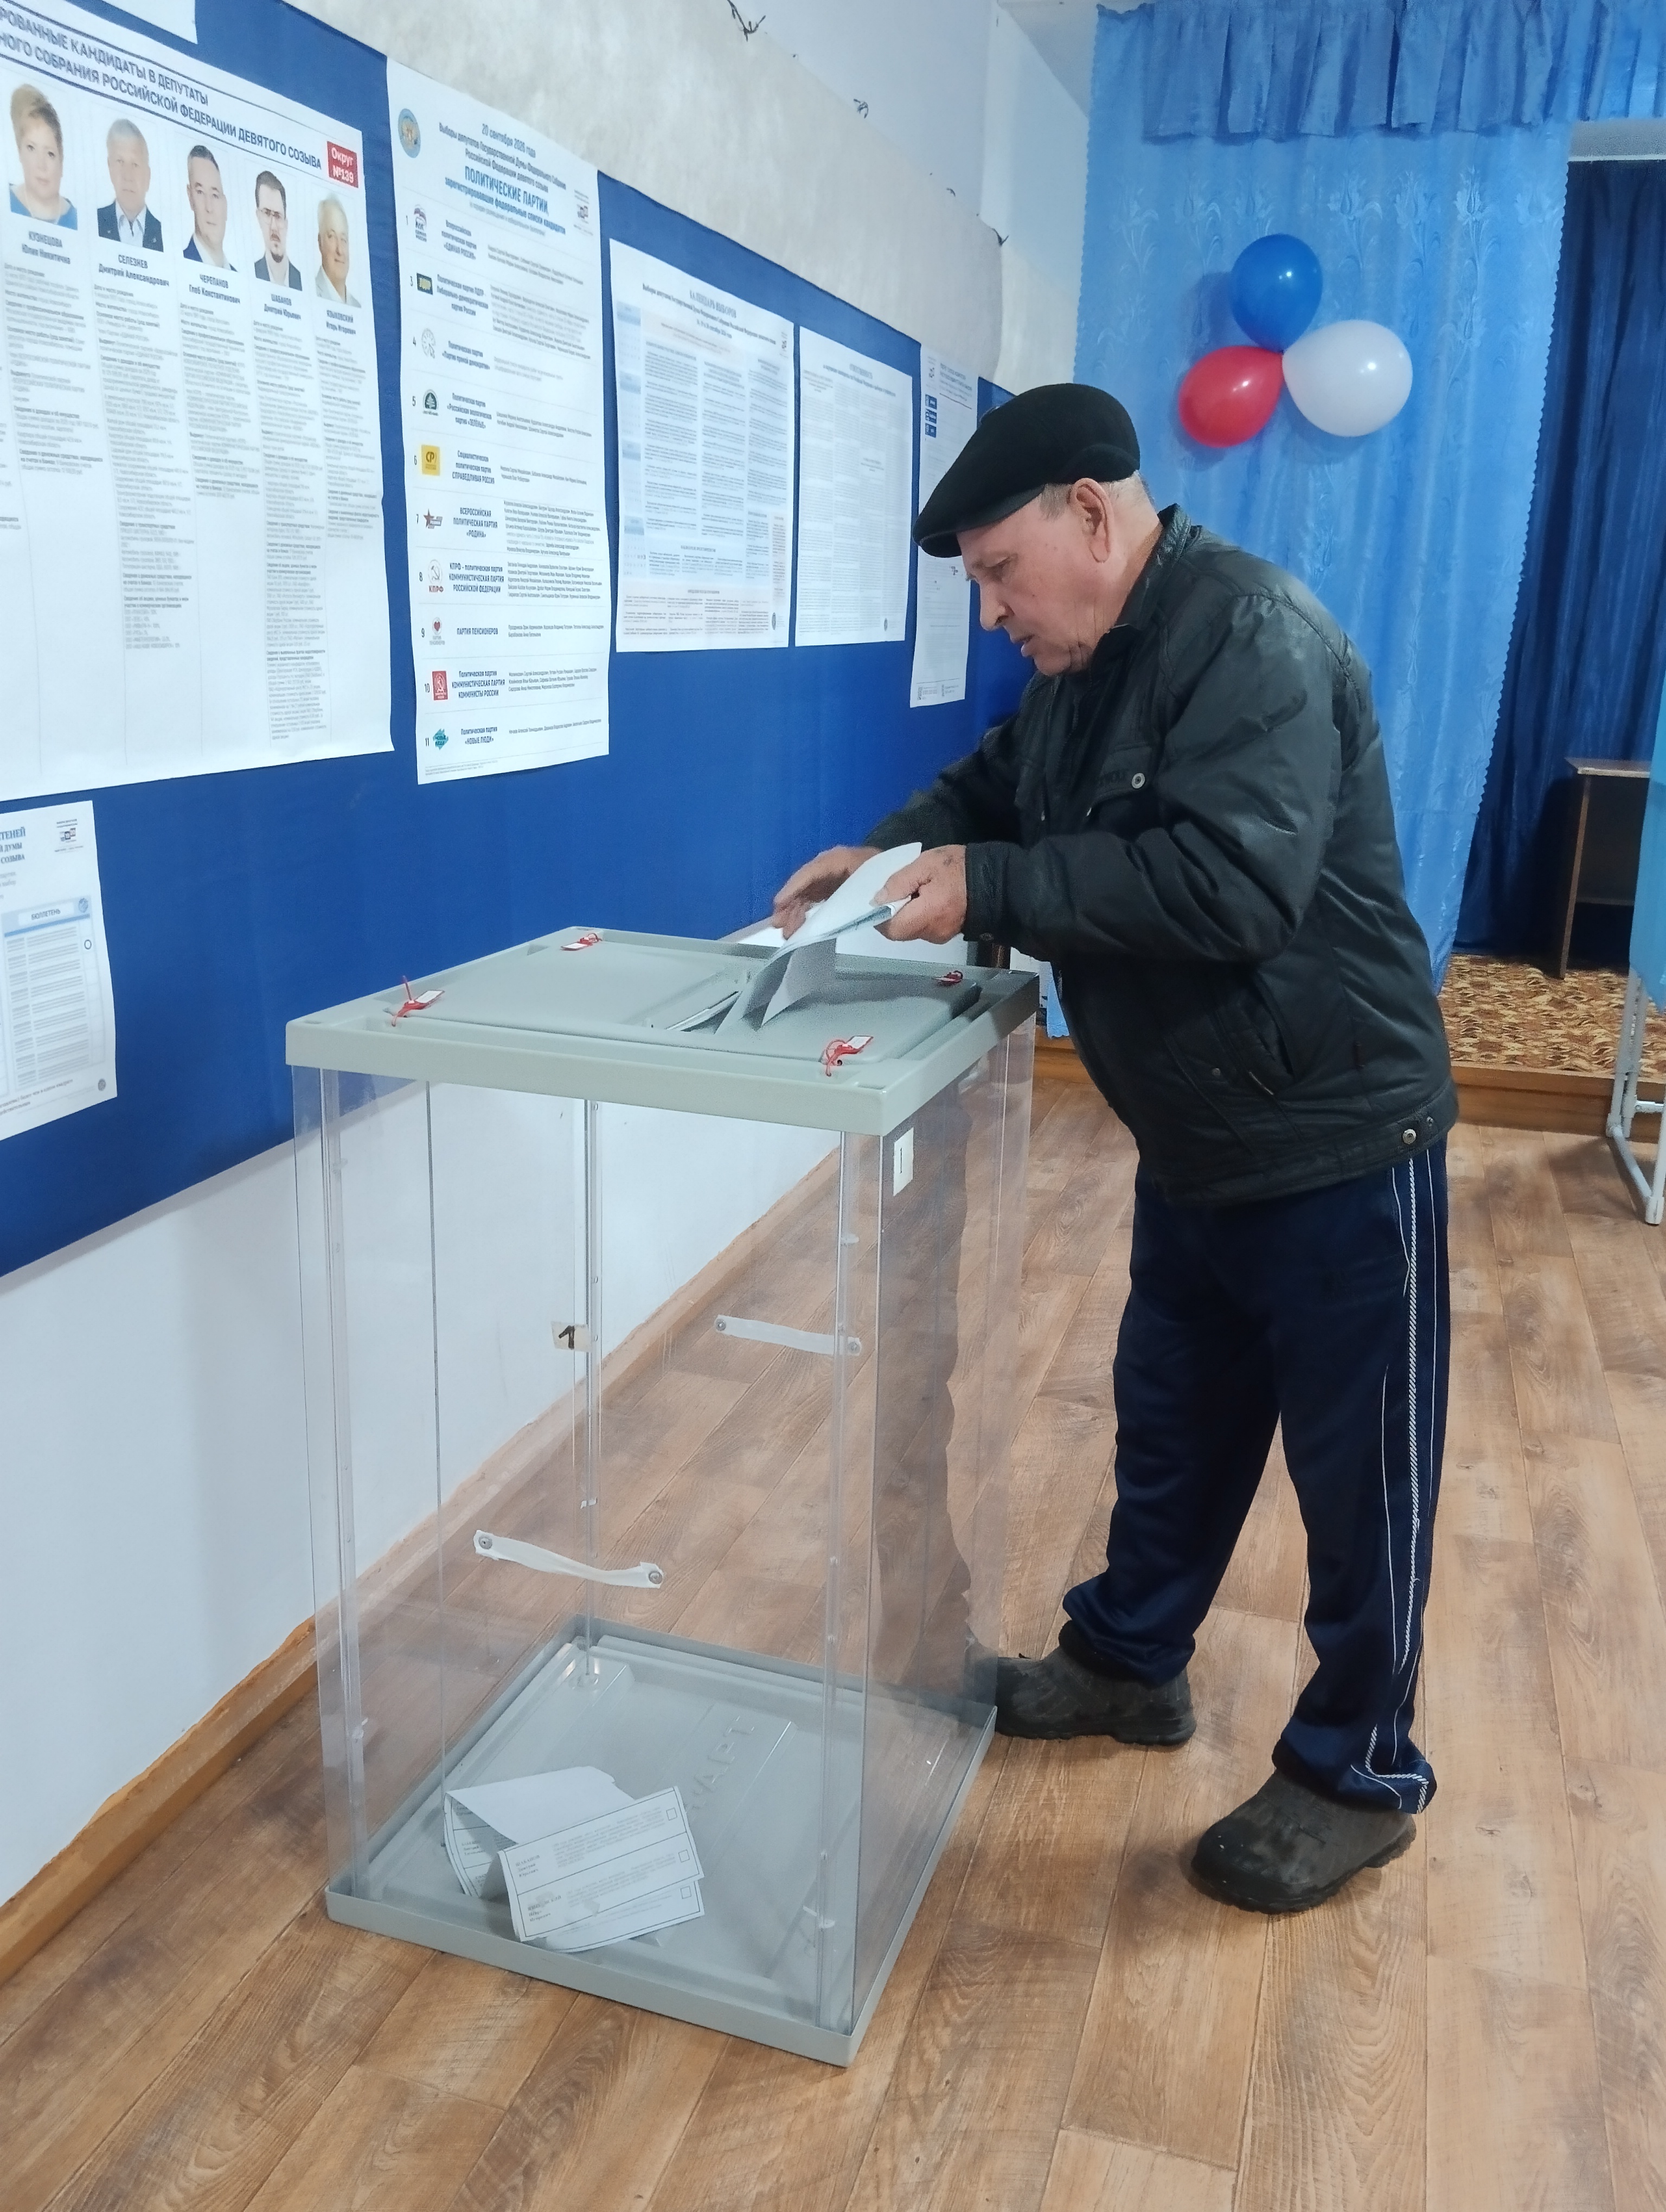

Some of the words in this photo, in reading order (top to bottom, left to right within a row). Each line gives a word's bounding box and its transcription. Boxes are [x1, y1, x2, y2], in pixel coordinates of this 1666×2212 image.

[72, 40, 146, 80] КАНДИДАТЫ
[149, 68, 156, 83] В
[158, 74, 208, 106] ДЕПУТАТЫ
[35, 46, 100, 83] СОБРАНИЯ
[102, 71, 178, 114] РОССИЙСКОЙ
[181, 102, 236, 138] ФЕДЕРАЦИИ
[239, 128, 286, 156] ДЕВЯТОГО
[289, 146, 322, 170] СОЗЫВА
[331, 147, 354, 166] Округ
[332, 165, 354, 183] №139
[465, 165, 521, 203] ПОЛИТИЧЕСКИЕ
[118, 254, 148, 269] СЕЛЕЗНЕВ
[99, 263, 124, 278] Дмитрий
[126, 270, 169, 287] Александрович
[200, 274, 228, 288] ЧЕРЕПАНОВ
[189, 284, 201, 294] Глеб
[412, 396, 416, 407] 5
[414, 455, 417, 466] 6
[416, 513, 419, 524] 7
[453, 517, 483, 527] ПОЛИТИЧЕСКАЯ
[484, 520, 498, 529] ПАРТИЯ
[450, 562, 462, 570] КПРФ
[419, 571, 423, 582] 8
[449, 573, 490, 582] КОММУНИСТИЧЕСКАЯ
[429, 585, 444, 593] КПРФ
[453, 583, 478, 592] РОССИЙСКОЙ
[479, 586, 501, 594] ФЕДЕРАЦИИ
[421, 628, 425, 638] 9
[425, 683, 430, 693] 10
[452, 680, 490, 689] КОММУНИСТИЧЕСКАЯ
[491, 679, 505, 687] ПАРТИЯ
[484, 689, 499, 697] РОССИИ
[425, 737, 430, 747] 11
[4, 843, 22, 852] ДУМЫ
[1, 854, 25, 864] СОЗЫВА
[31, 909, 61, 921] БЮЛЛЕТЕНЬ
[558, 1325, 575, 1350] 1
